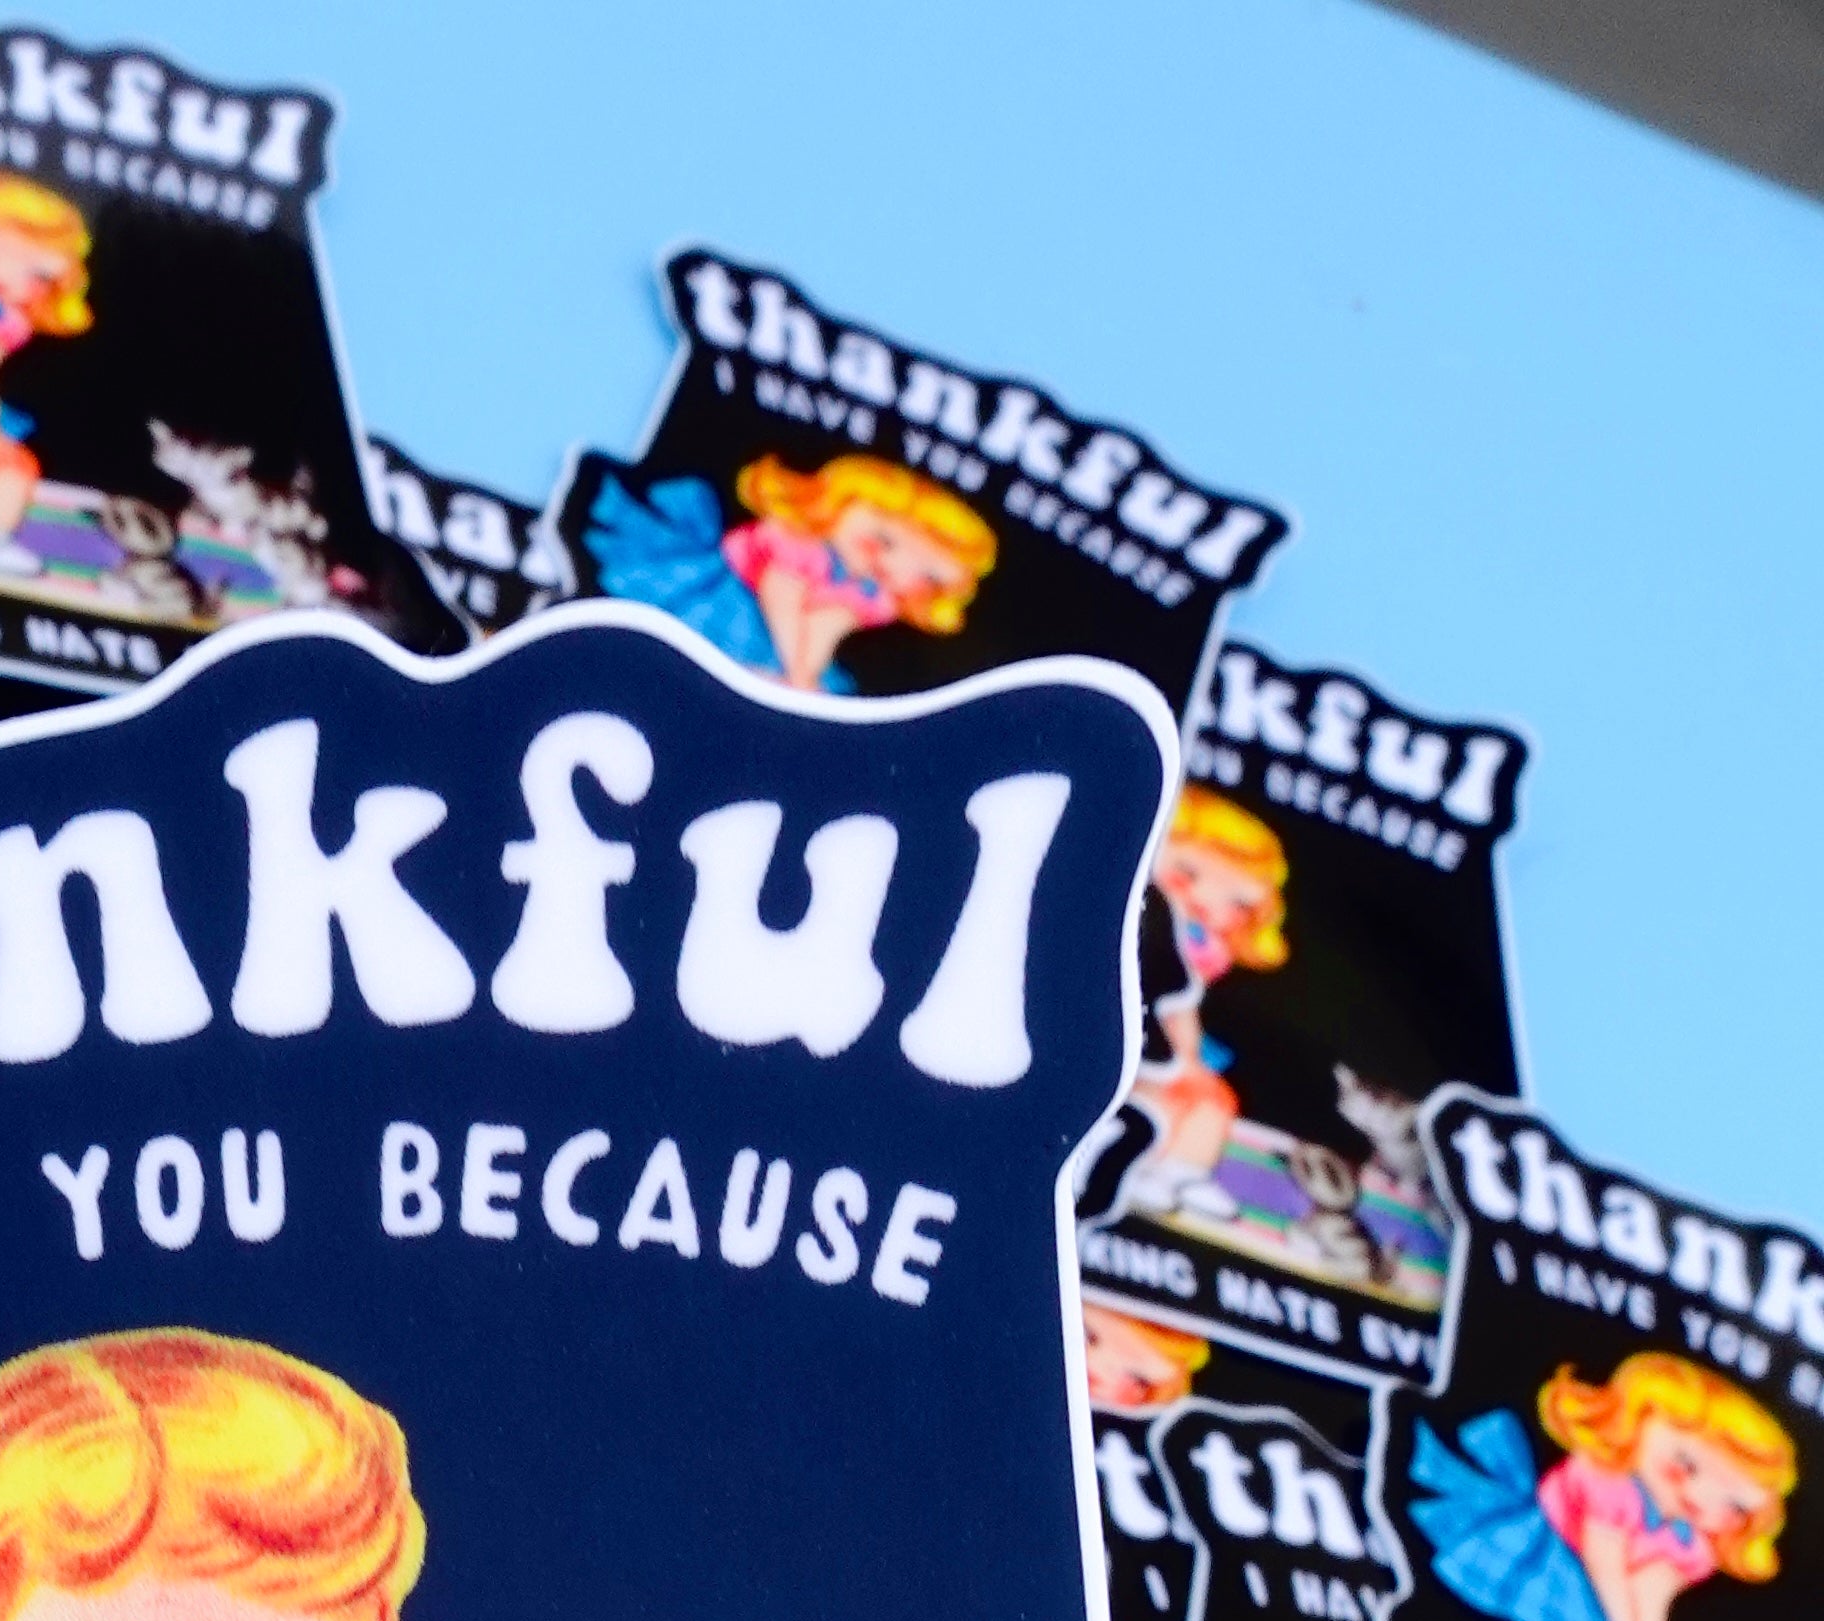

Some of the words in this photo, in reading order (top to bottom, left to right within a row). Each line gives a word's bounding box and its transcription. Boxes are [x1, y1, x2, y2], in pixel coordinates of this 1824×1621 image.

[62, 138, 275, 231] BECAUSE
[686, 259, 1267, 581] thankful
[714, 354, 736, 396] I
[754, 367, 875, 446] HAVE
[23, 613, 162, 676] HATE
[1206, 650, 1508, 827] kful
[1264, 758, 1468, 874] BECAUSE
[40, 1126, 286, 1262] YOU
[380, 1120, 958, 1308] BECAUSE
[1217, 1267, 1342, 1345] HATE
[1492, 1237, 1519, 1286] I
[1534, 1251, 1656, 1333] HAVE
[1681, 1304, 1772, 1381] YOU
